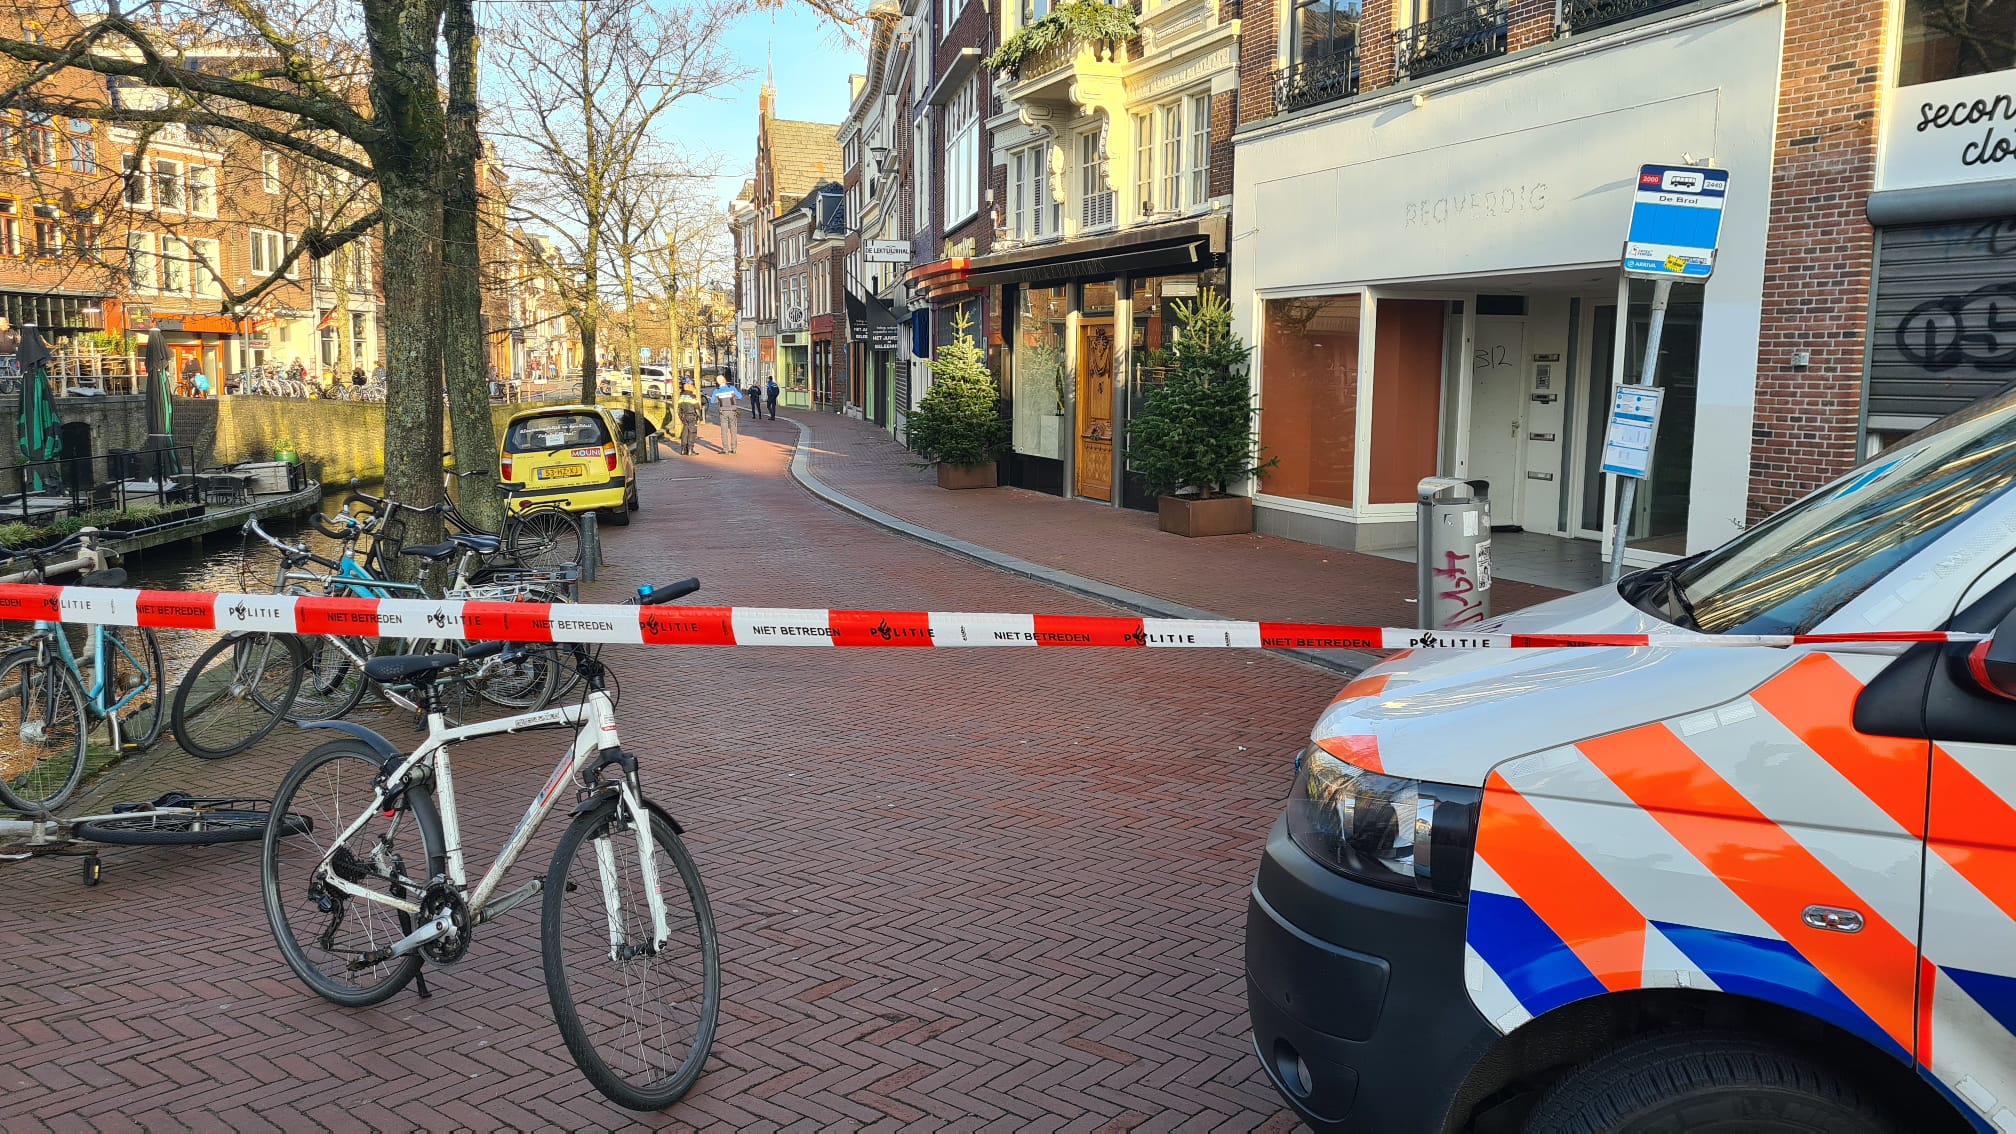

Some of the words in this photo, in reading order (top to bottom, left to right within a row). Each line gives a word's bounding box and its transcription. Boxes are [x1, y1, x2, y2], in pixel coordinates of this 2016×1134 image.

[1916, 94, 2016, 132] secon
[1961, 127, 2016, 166] clo
[136, 604, 154, 614] NIET
[157, 605, 206, 616] BETREDEN
[327, 612, 348, 622] NIET
[351, 613, 403, 624] BETREDEN
[532, 619, 555, 629] NIET
[557, 620, 613, 631] BETREDEN
[752, 625, 777, 635] NIET
[780, 626, 841, 637] BETREDEN
[993, 631, 1021, 640] NIET
[1024, 632, 1090, 642] BETREDEN
[1262, 638, 1292, 646] NIET
[1296, 638, 1371, 648] BETREDEN
